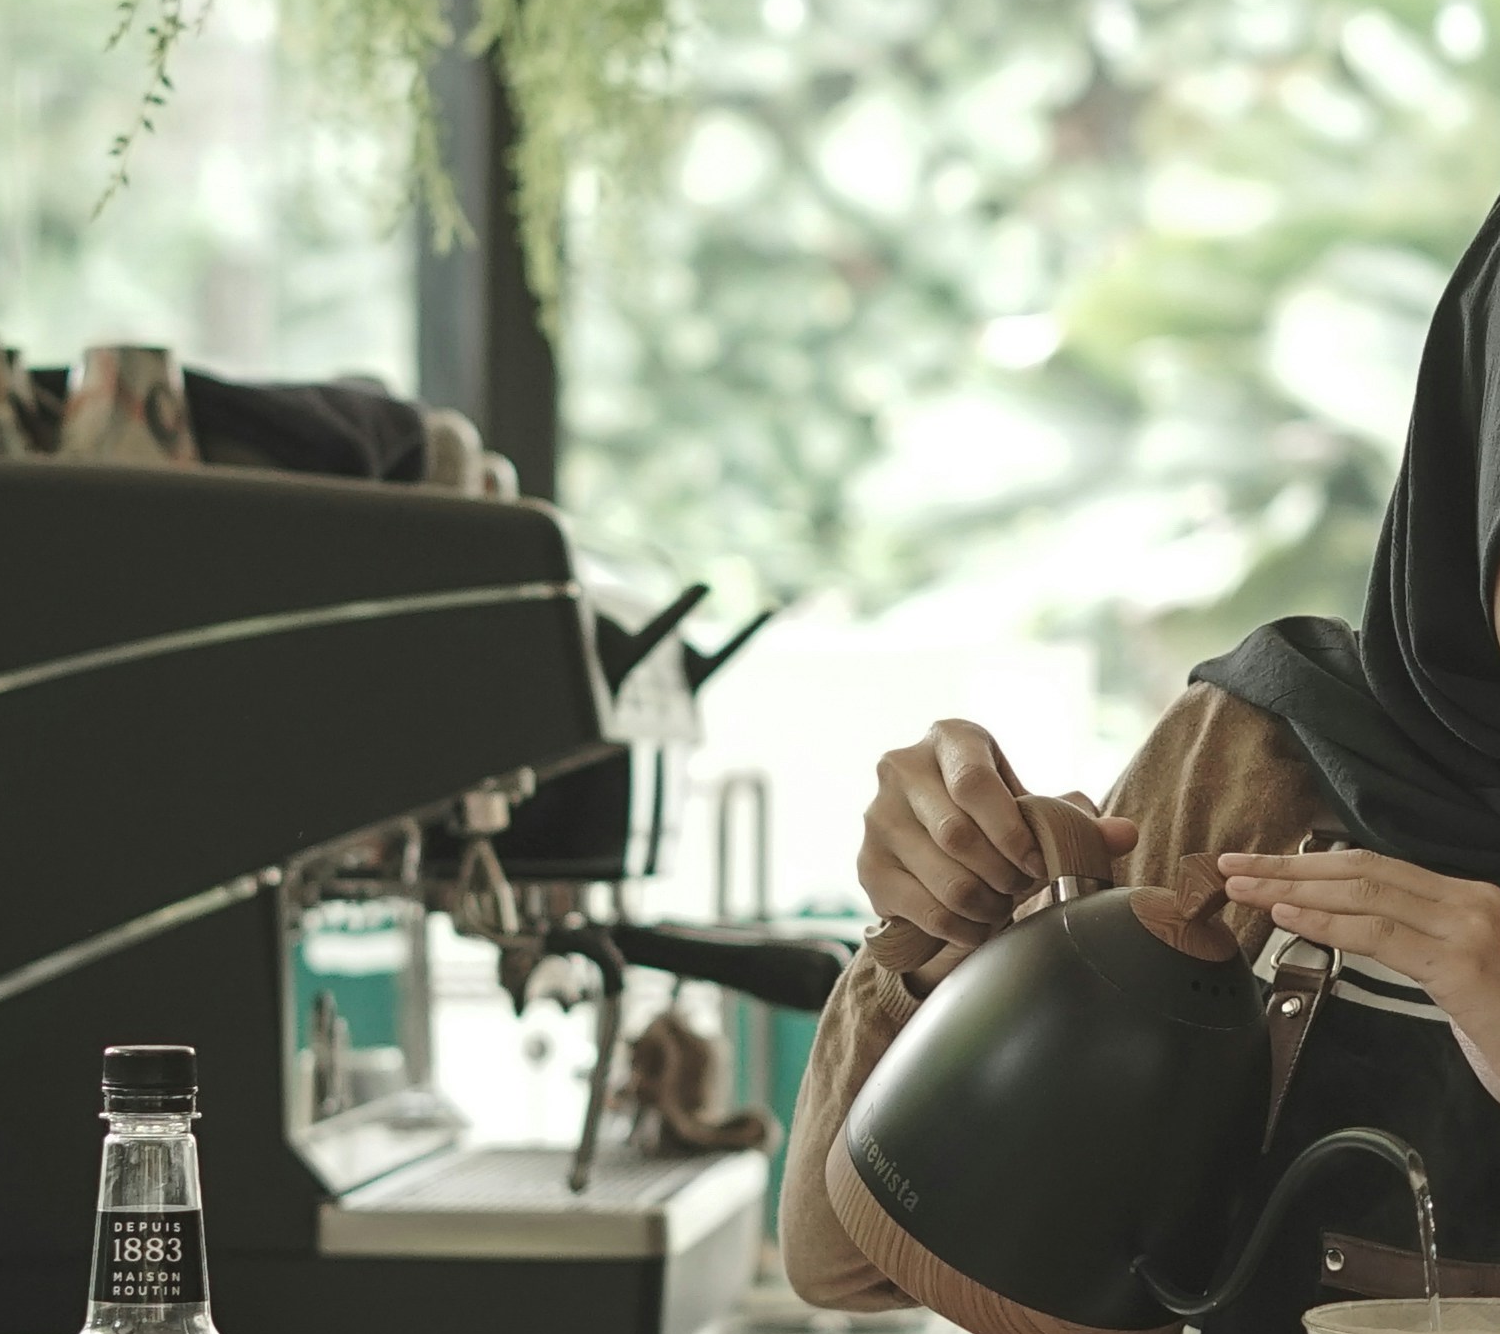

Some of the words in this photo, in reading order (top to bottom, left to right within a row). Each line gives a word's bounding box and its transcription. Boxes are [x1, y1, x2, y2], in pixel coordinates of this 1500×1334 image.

[113, 1221, 181, 1233] DEPUIS
[112, 1237, 182, 1262] 1883
[112, 1271, 181, 1282] MAISON
[112, 1285, 181, 1296] ROUTIN
